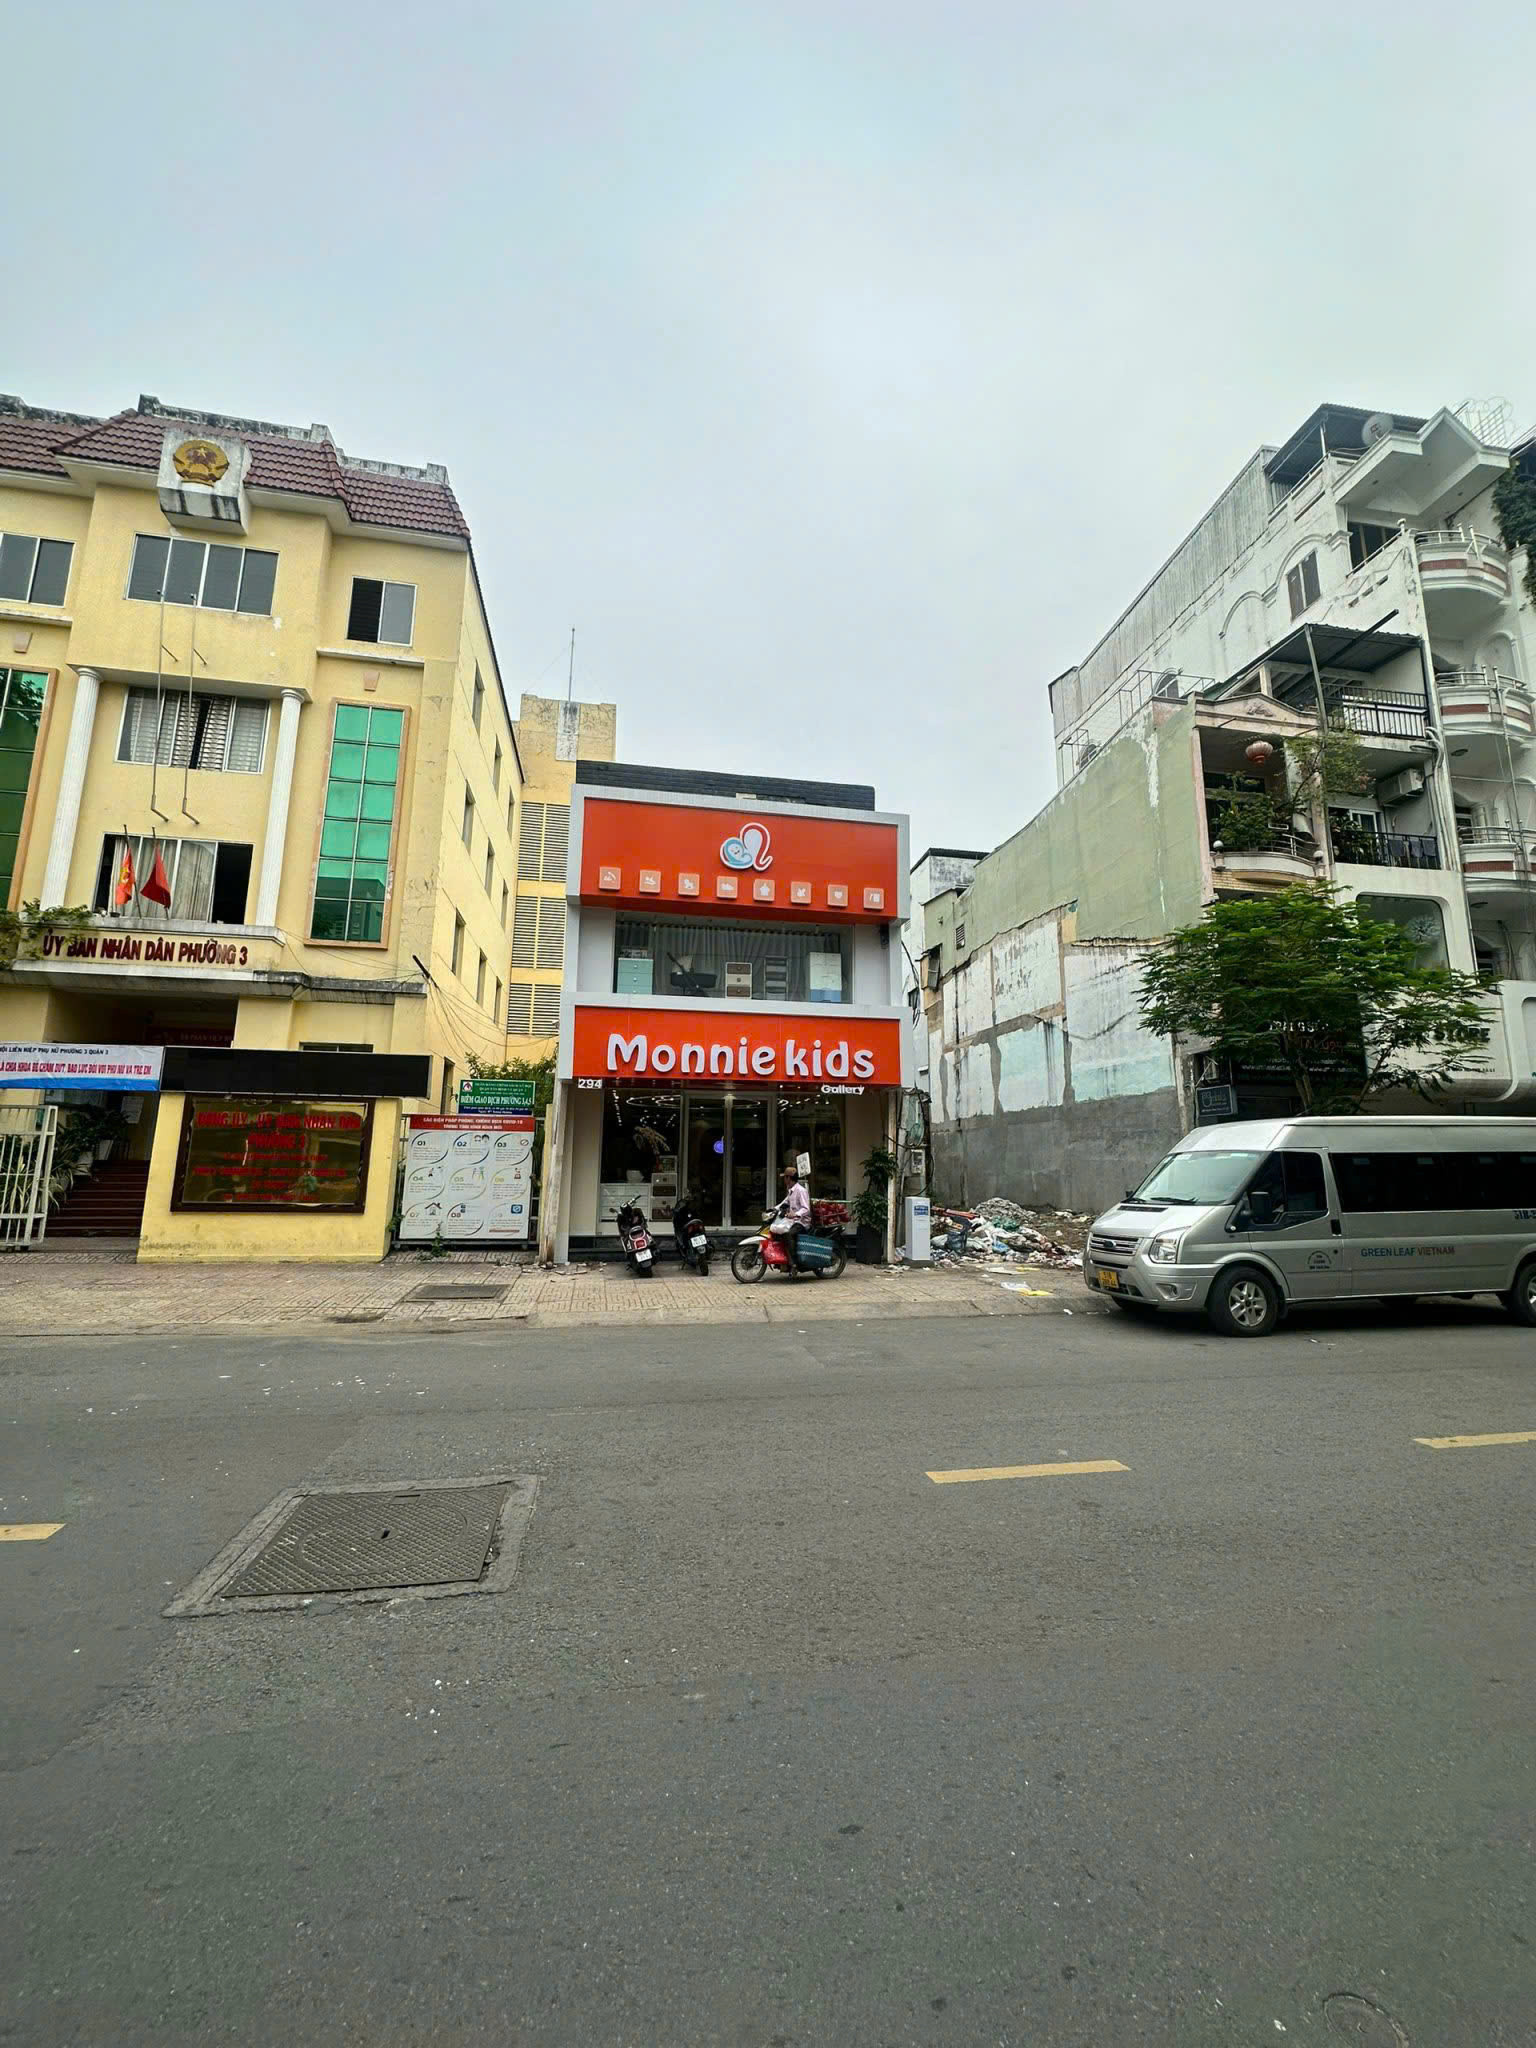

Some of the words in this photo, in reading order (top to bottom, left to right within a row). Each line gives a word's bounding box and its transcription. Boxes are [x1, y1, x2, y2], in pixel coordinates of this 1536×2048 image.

[43, 929, 65, 956] ỦY
[100, 935, 141, 960] NHÂN
[144, 937, 175, 962] DÂN
[178, 938, 236, 964] PHƯỜNG
[239, 946, 249, 966] 3
[607, 1033, 776, 1075] Monnie
[785, 1039, 875, 1078] kids
[578, 1077, 602, 1089] 294
[821, 1084, 865, 1096] Gallery
[1361, 1248, 1392, 1257] GREEN
[1394, 1247, 1416, 1257] LEAF
[1417, 1246, 1456, 1257] VIETNAM
